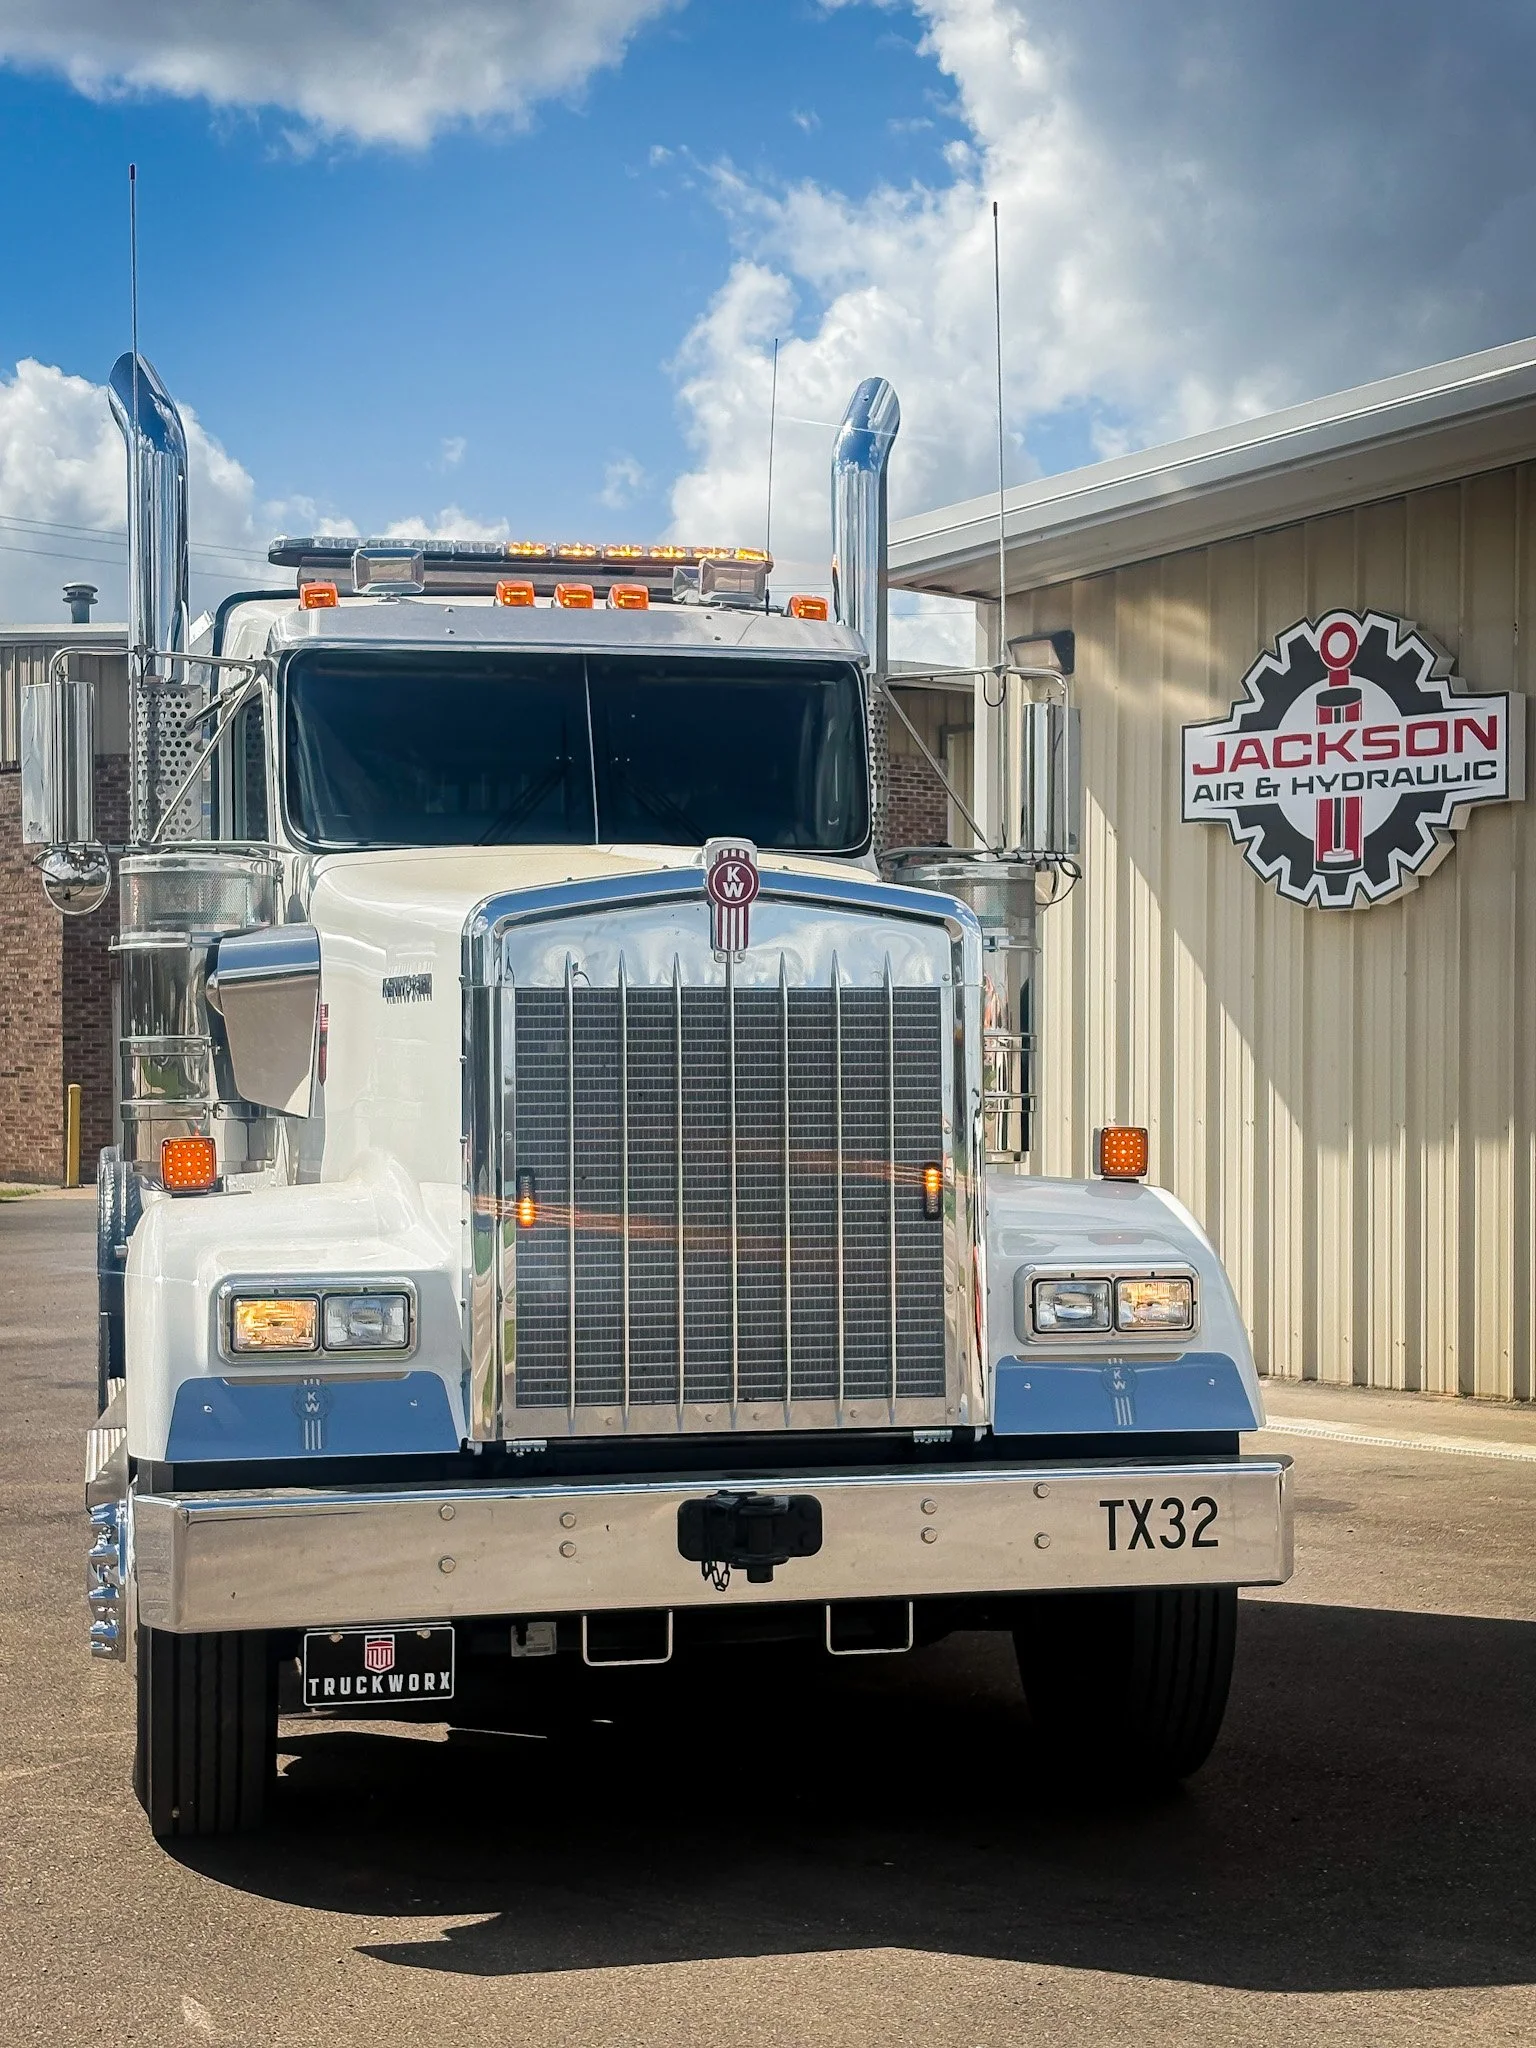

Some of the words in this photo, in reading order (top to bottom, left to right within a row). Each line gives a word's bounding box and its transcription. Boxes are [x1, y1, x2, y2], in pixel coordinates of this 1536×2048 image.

[1193, 715, 1497, 775] JACKSON
[1193, 782, 1244, 803] AIR
[1256, 777, 1281, 798] &
[1292, 760, 1497, 795] HYDRAULIC
[1099, 1496, 1219, 1551] TX32
[308, 1671, 450, 1697] TRUCKWORX
